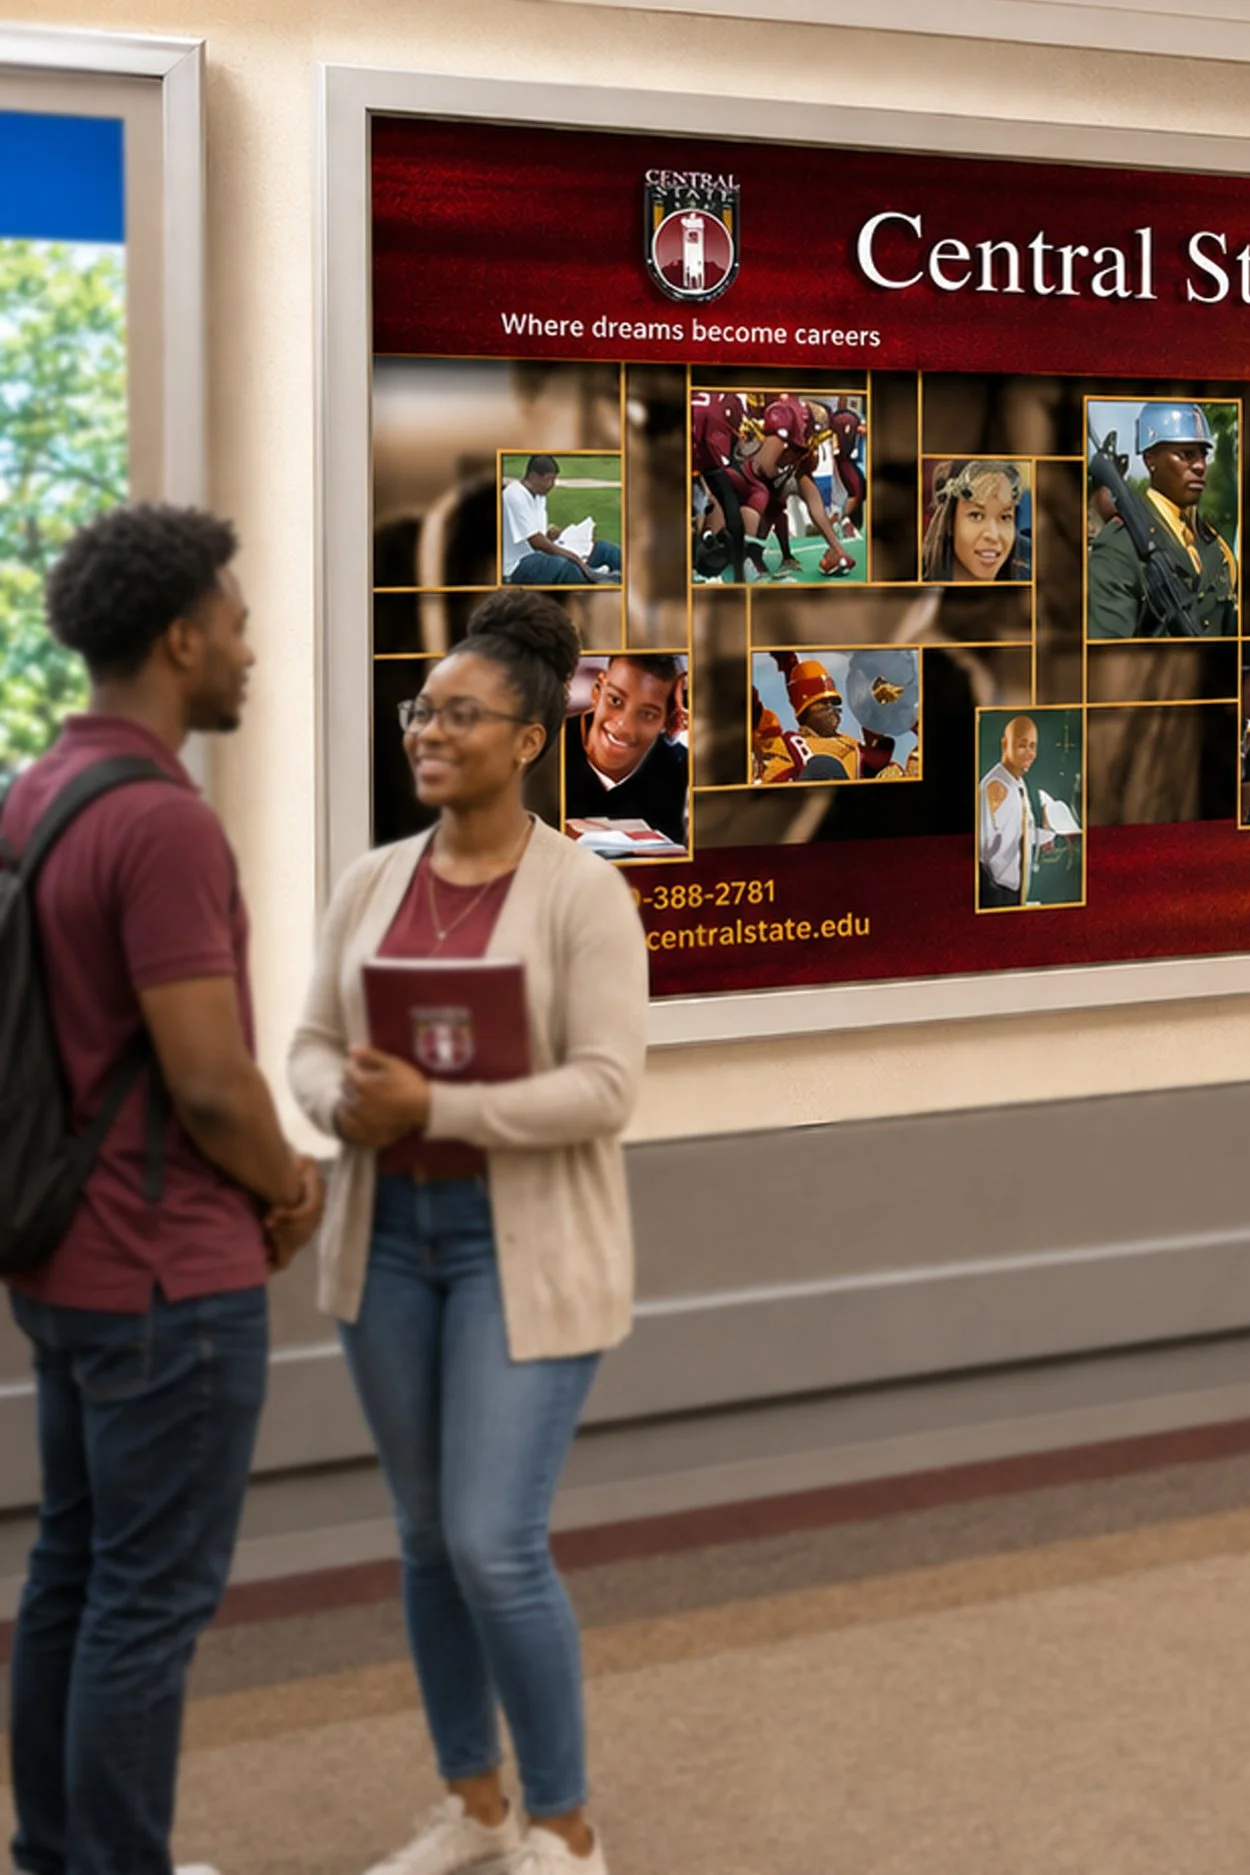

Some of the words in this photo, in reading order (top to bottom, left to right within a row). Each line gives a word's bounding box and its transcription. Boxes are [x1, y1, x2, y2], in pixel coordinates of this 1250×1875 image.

[644, 168, 741, 191] CENTRAL
[857, 211, 1158, 299] Central
[501, 312, 584, 338] Where
[592, 316, 684, 342] dreams
[692, 318, 788, 344] become
[794, 325, 881, 347] careers
